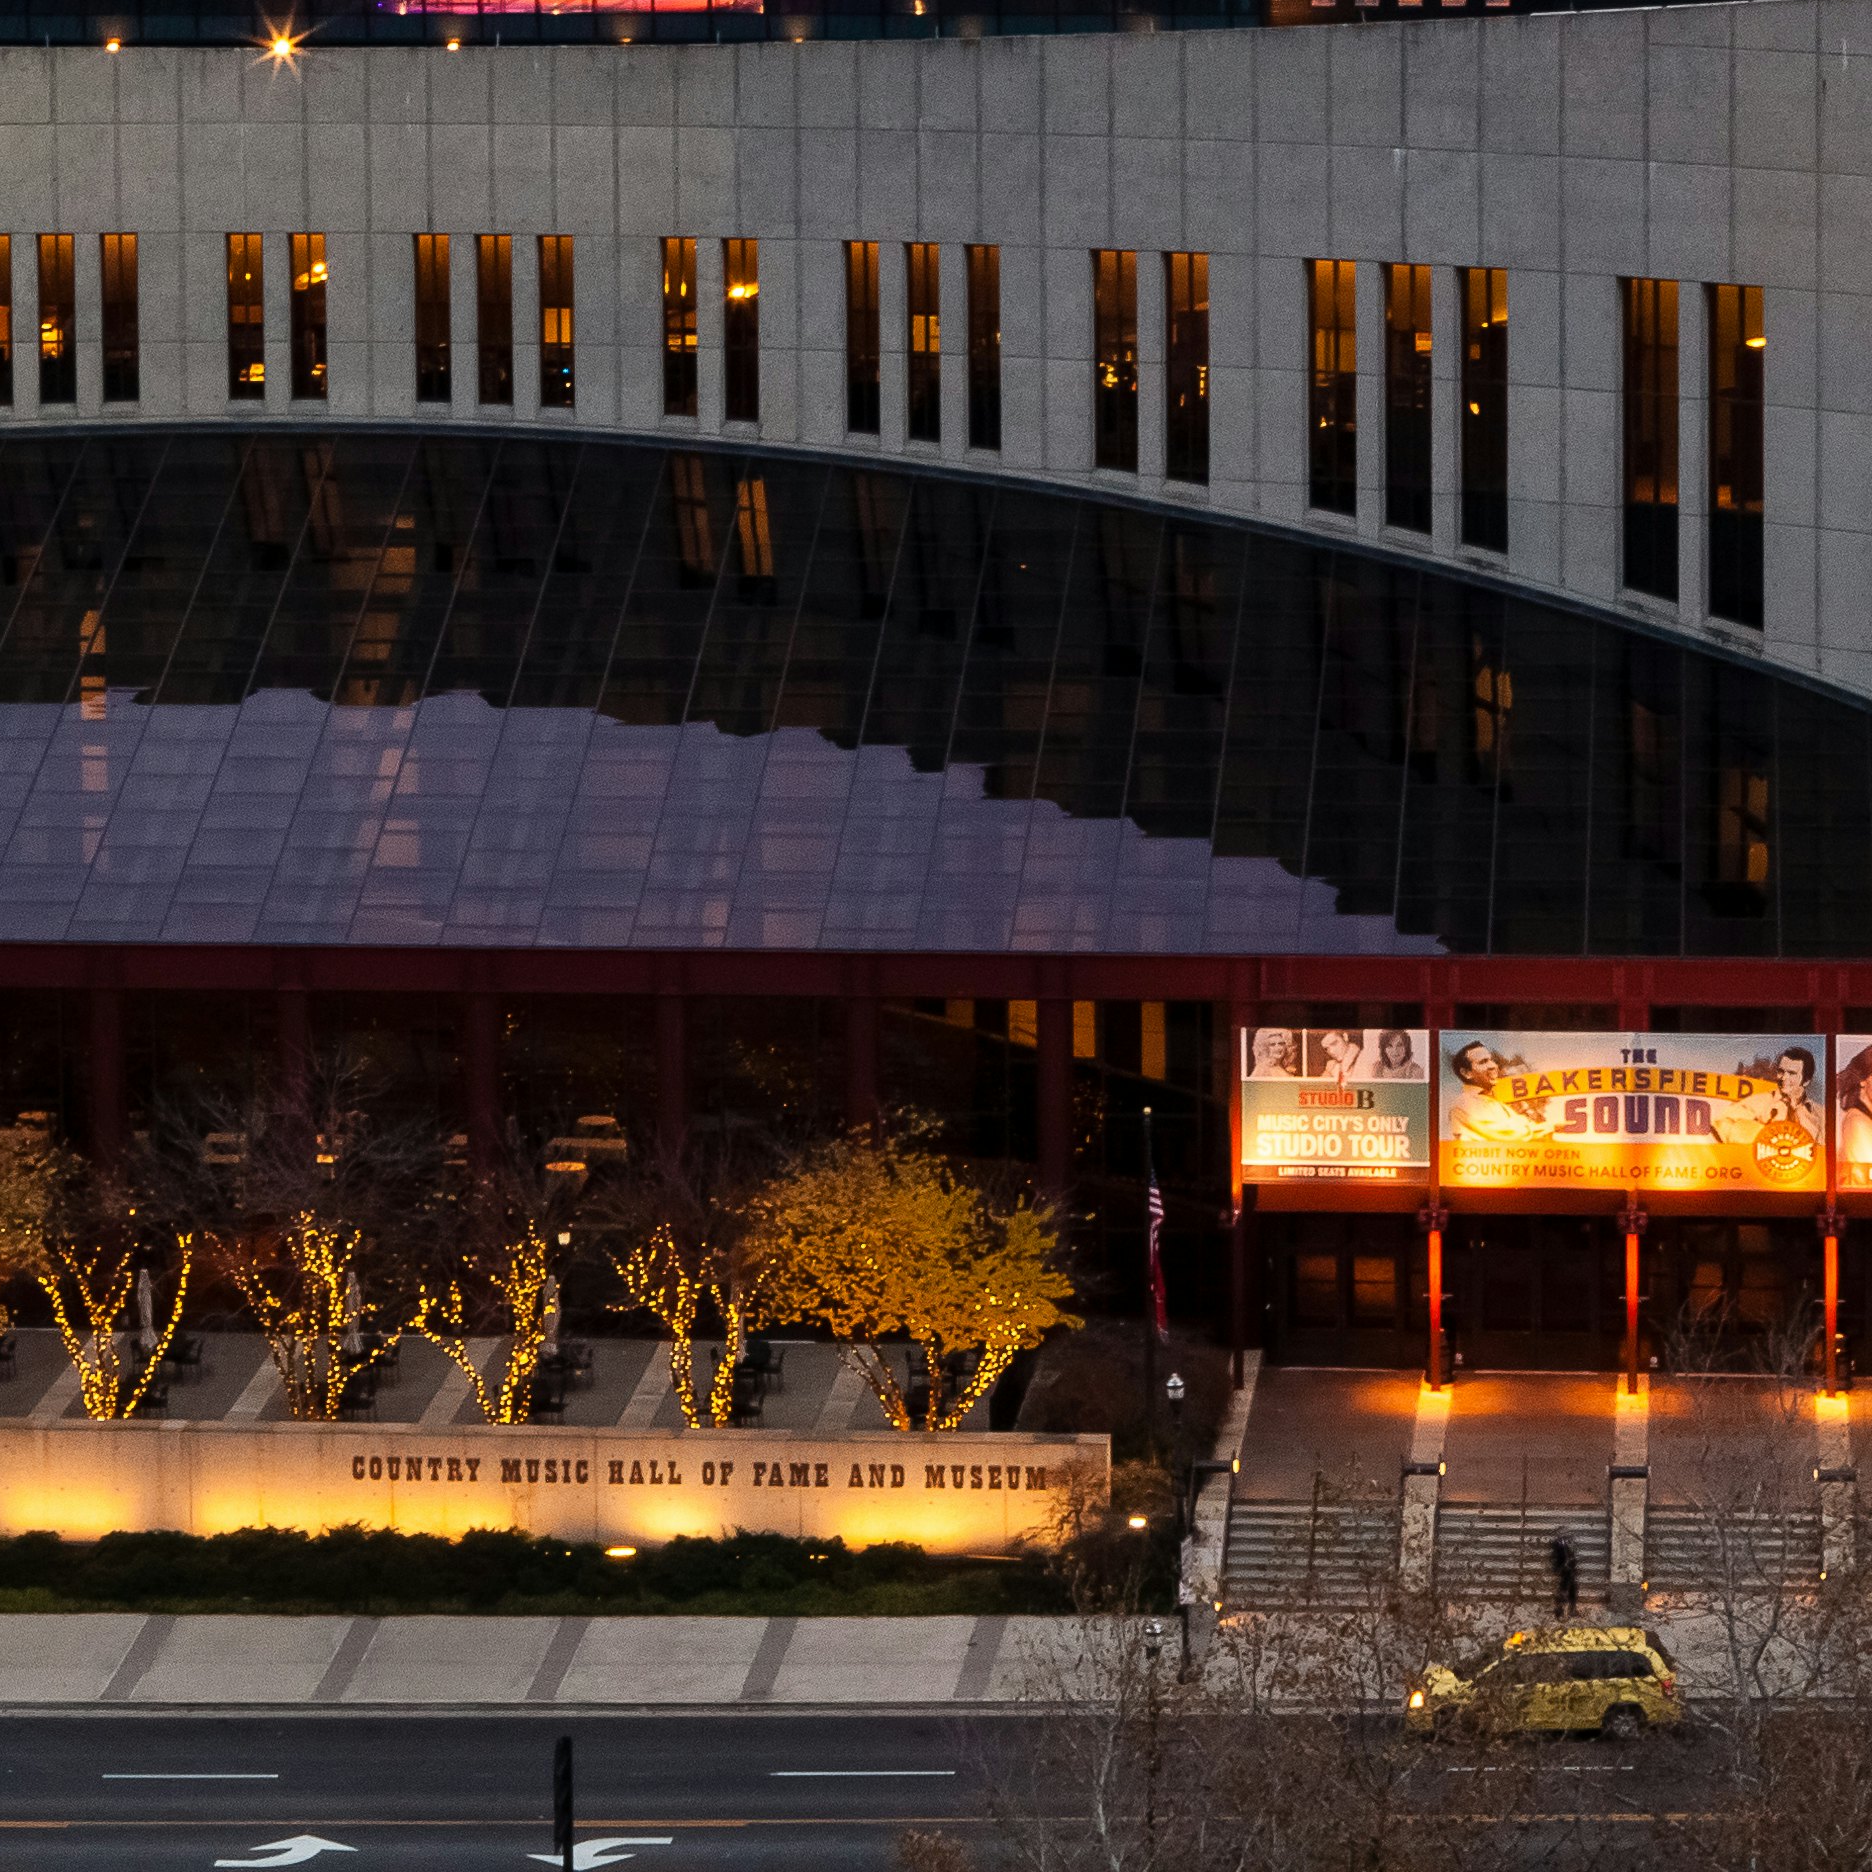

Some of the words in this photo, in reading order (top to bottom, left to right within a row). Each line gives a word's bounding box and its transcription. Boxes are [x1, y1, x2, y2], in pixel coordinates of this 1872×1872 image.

[1620, 1048, 1658, 1065] THE
[1511, 1068, 1755, 1099] BAKERSFIELD
[1357, 1089, 1375, 1110] B
[1257, 1115, 1308, 1132] MUSIC
[1313, 1116, 1364, 1133] CITY'S
[1367, 1116, 1410, 1134] ONLY
[1563, 1094, 1713, 1136] SOUND
[1257, 1134, 1342, 1158] STUDIO
[1348, 1135, 1411, 1159] TOUR
[1453, 1148, 1501, 1159] EXHIBIT
[1506, 1148, 1538, 1159] NOW
[1544, 1149, 1580, 1159] OPEN
[1278, 1167, 1315, 1177] LIMITED
[1318, 1167, 1345, 1177] SEATS
[1347, 1168, 1397, 1178] AVAILABLE
[352, 1455, 482, 1482] COUNTRY
[500, 1457, 589, 1484] MUSIC
[608, 1459, 683, 1485] HALL
[702, 1461, 734, 1486] OF
[753, 1461, 830, 1488] FAME
[848, 1463, 905, 1489] AND
[924, 1464, 1049, 1491] MUSEUM
